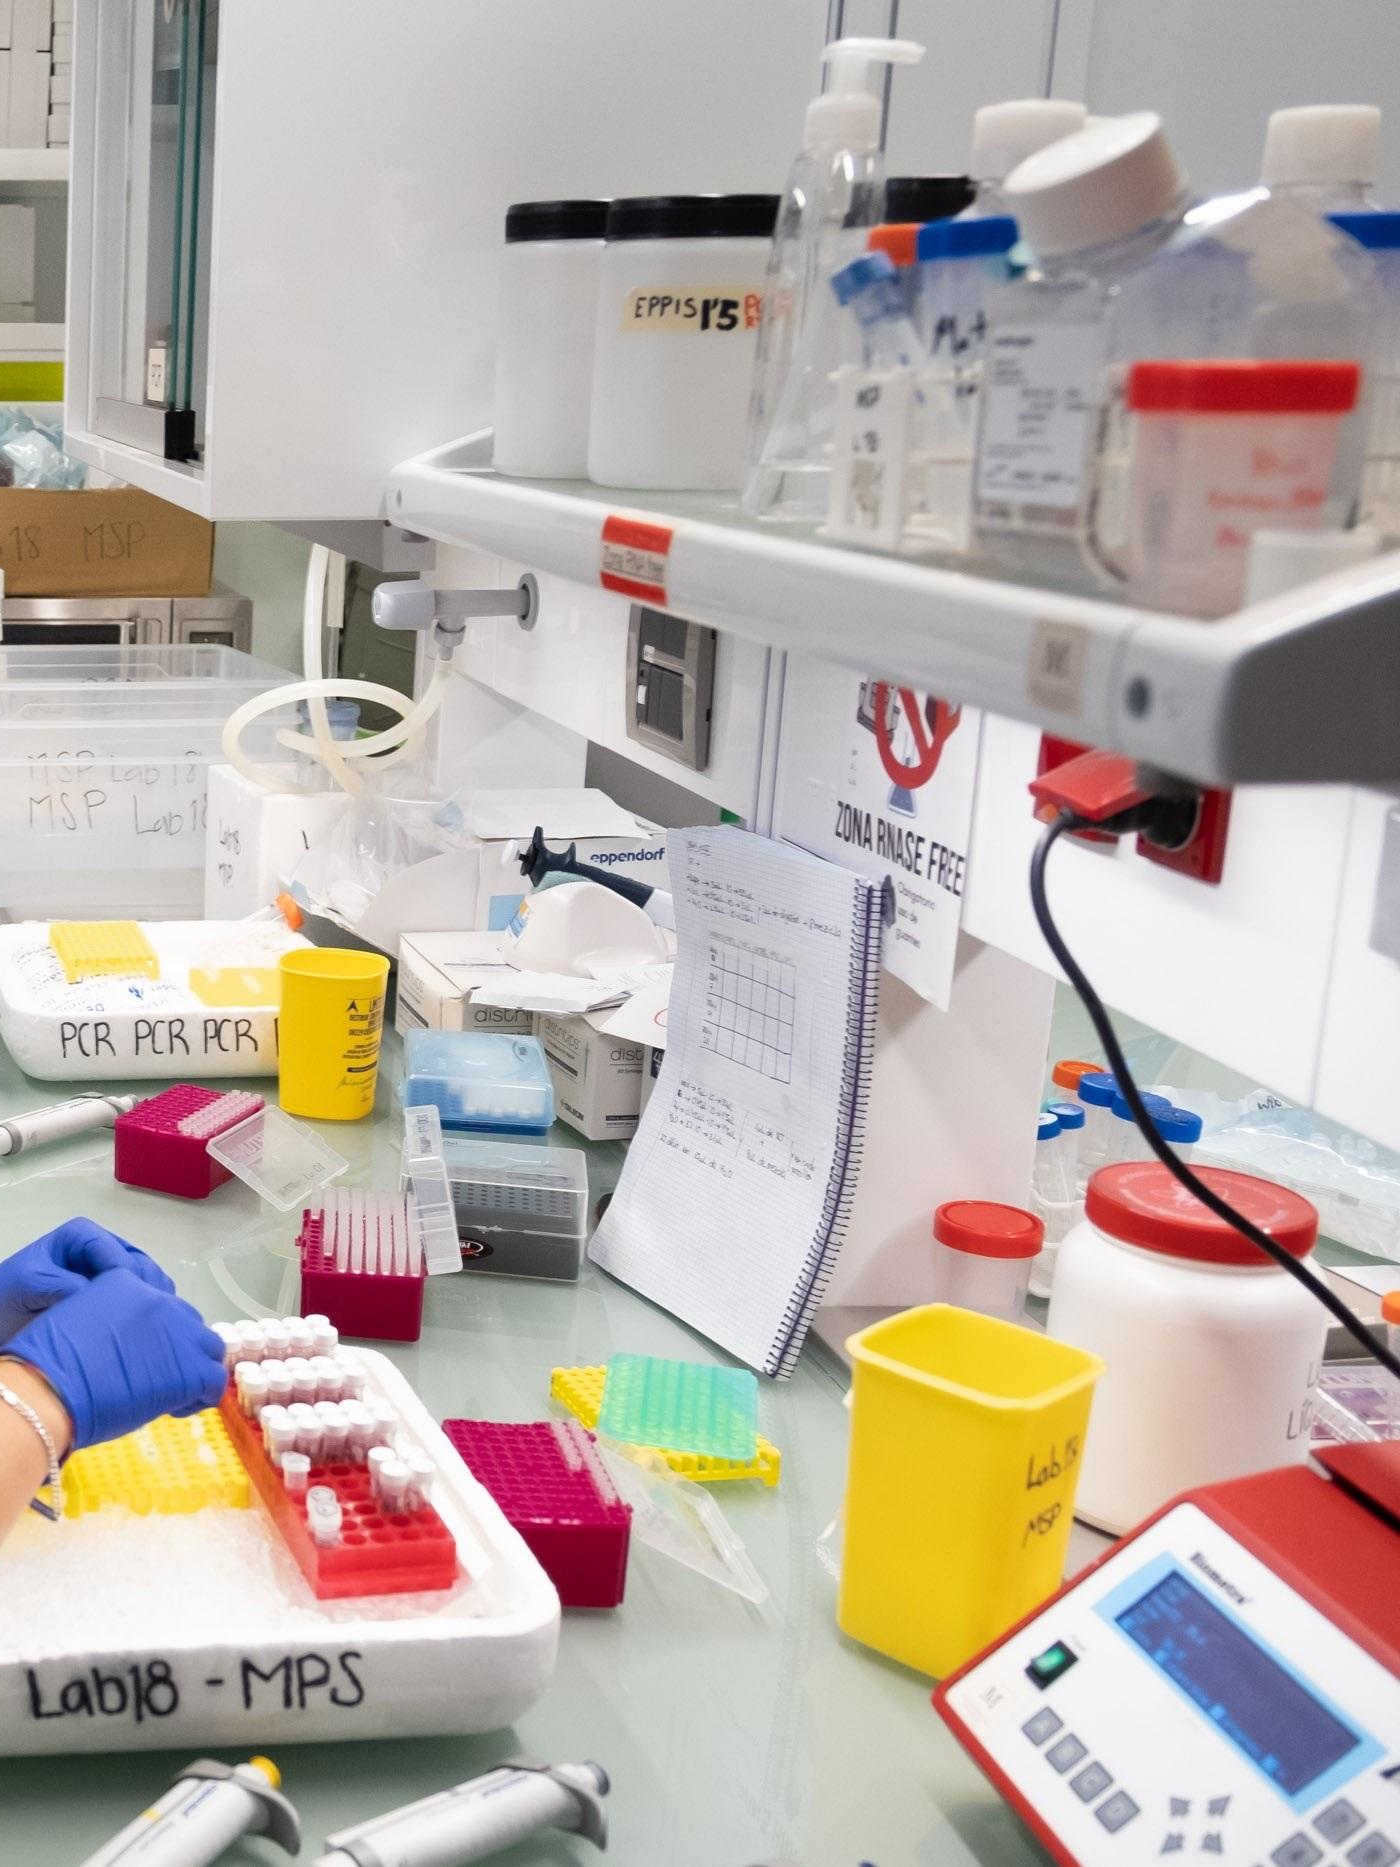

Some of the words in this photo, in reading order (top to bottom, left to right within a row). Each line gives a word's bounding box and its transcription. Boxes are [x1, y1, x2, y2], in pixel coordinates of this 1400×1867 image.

[634, 295, 698, 318] EPPIS
[84, 519, 146, 563] MSP
[28, 789, 108, 832] MSP
[590, 847, 666, 865] eppendorf
[834, 800, 873, 851] ZONA
[876, 817, 925, 877] RNASE
[926, 840, 965, 897] FREE
[60, 1021, 117, 1058] PCR
[134, 1018, 190, 1056] PCR
[203, 1018, 259, 1055] PCR
[24, 1658, 181, 1725] Lab18
[239, 1651, 365, 1710] MPS
